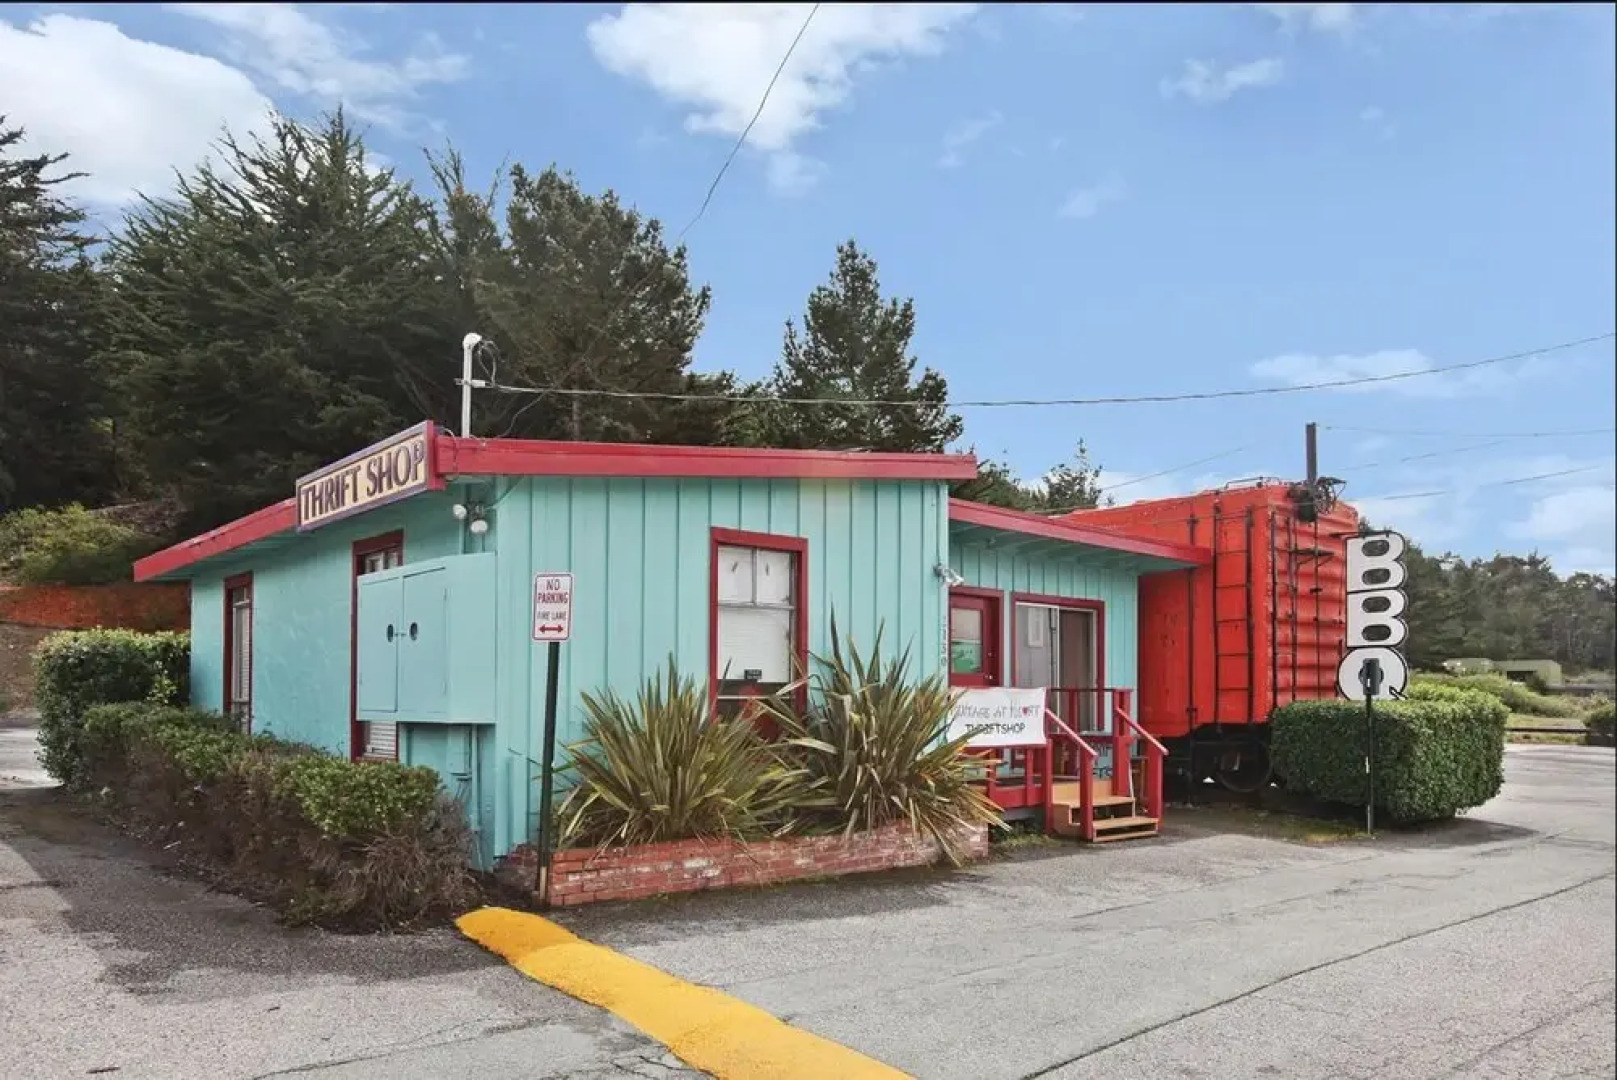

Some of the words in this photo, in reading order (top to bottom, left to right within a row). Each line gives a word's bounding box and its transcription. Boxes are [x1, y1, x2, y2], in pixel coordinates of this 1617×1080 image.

[301, 465, 361, 520] THRIFT
[366, 440, 425, 498] SHOP
[537, 592, 569, 604] PARKING
[546, 579, 561, 591] NO
[1338, 531, 1407, 700] BBQ
